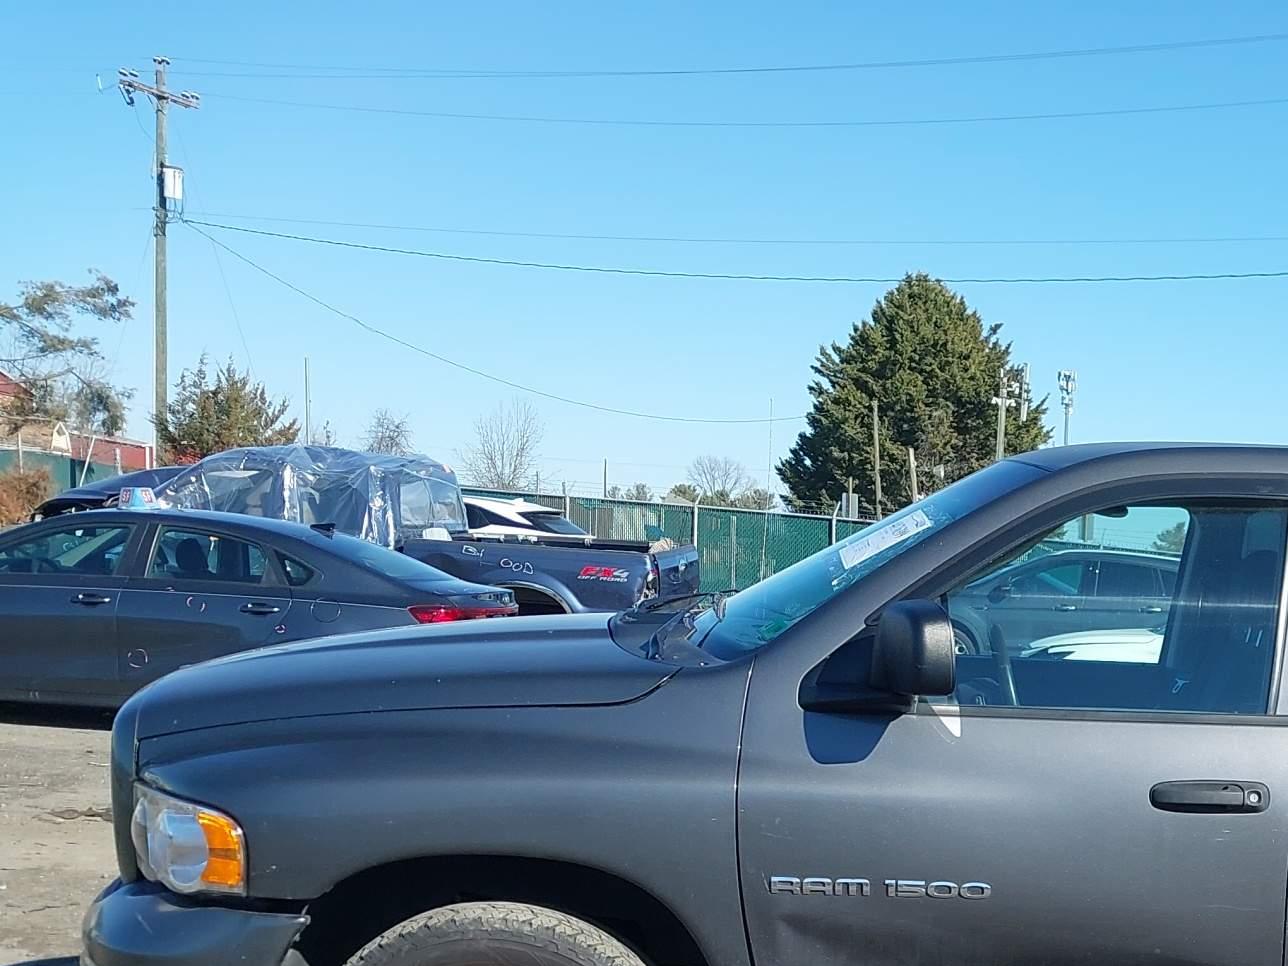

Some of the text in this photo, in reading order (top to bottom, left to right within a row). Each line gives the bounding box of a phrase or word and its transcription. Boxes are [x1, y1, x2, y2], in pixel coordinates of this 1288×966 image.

[580, 565, 630, 577] FX4
[769, 876, 992, 899] RAM 1500
